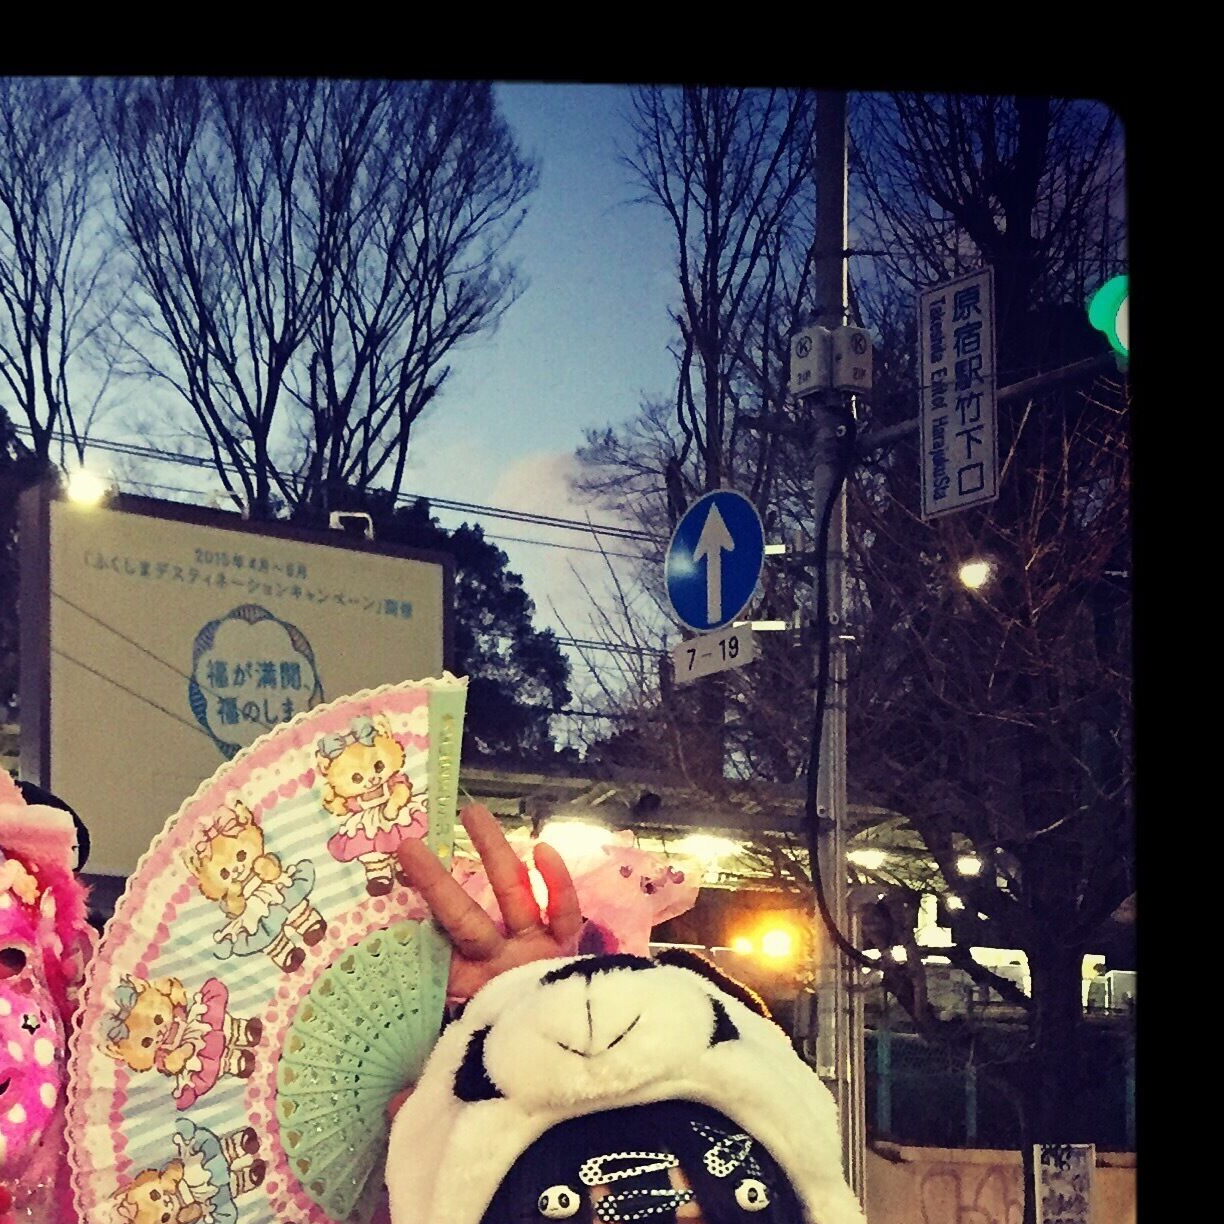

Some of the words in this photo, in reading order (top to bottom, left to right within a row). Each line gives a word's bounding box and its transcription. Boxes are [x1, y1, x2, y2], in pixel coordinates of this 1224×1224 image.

[952, 285, 985, 496] 原宿駅竹下口
